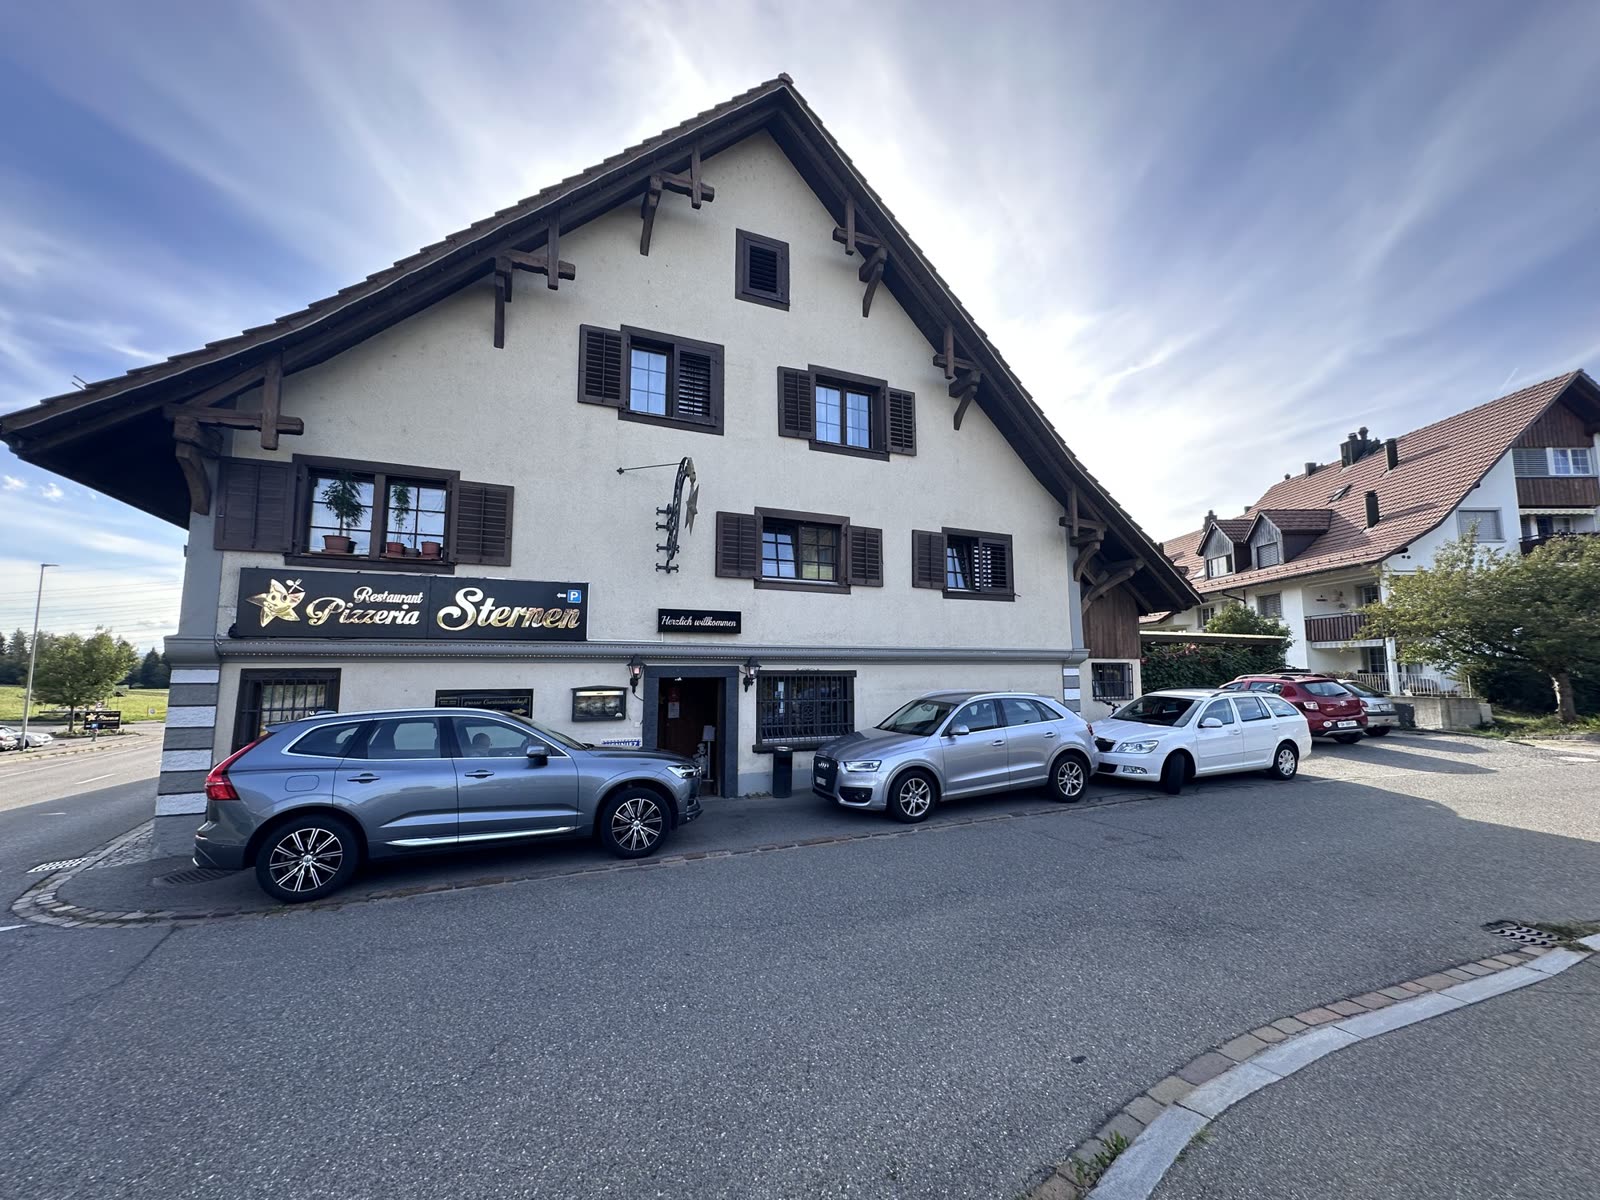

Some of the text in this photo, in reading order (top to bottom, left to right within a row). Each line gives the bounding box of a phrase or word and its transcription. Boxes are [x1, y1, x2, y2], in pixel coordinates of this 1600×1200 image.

[353, 586, 423, 604] Restaurant
[306, 597, 420, 626] Pizzeria
[437, 587, 580, 631] Sternen
[661, 615, 737, 627] Herzlich willkommen
